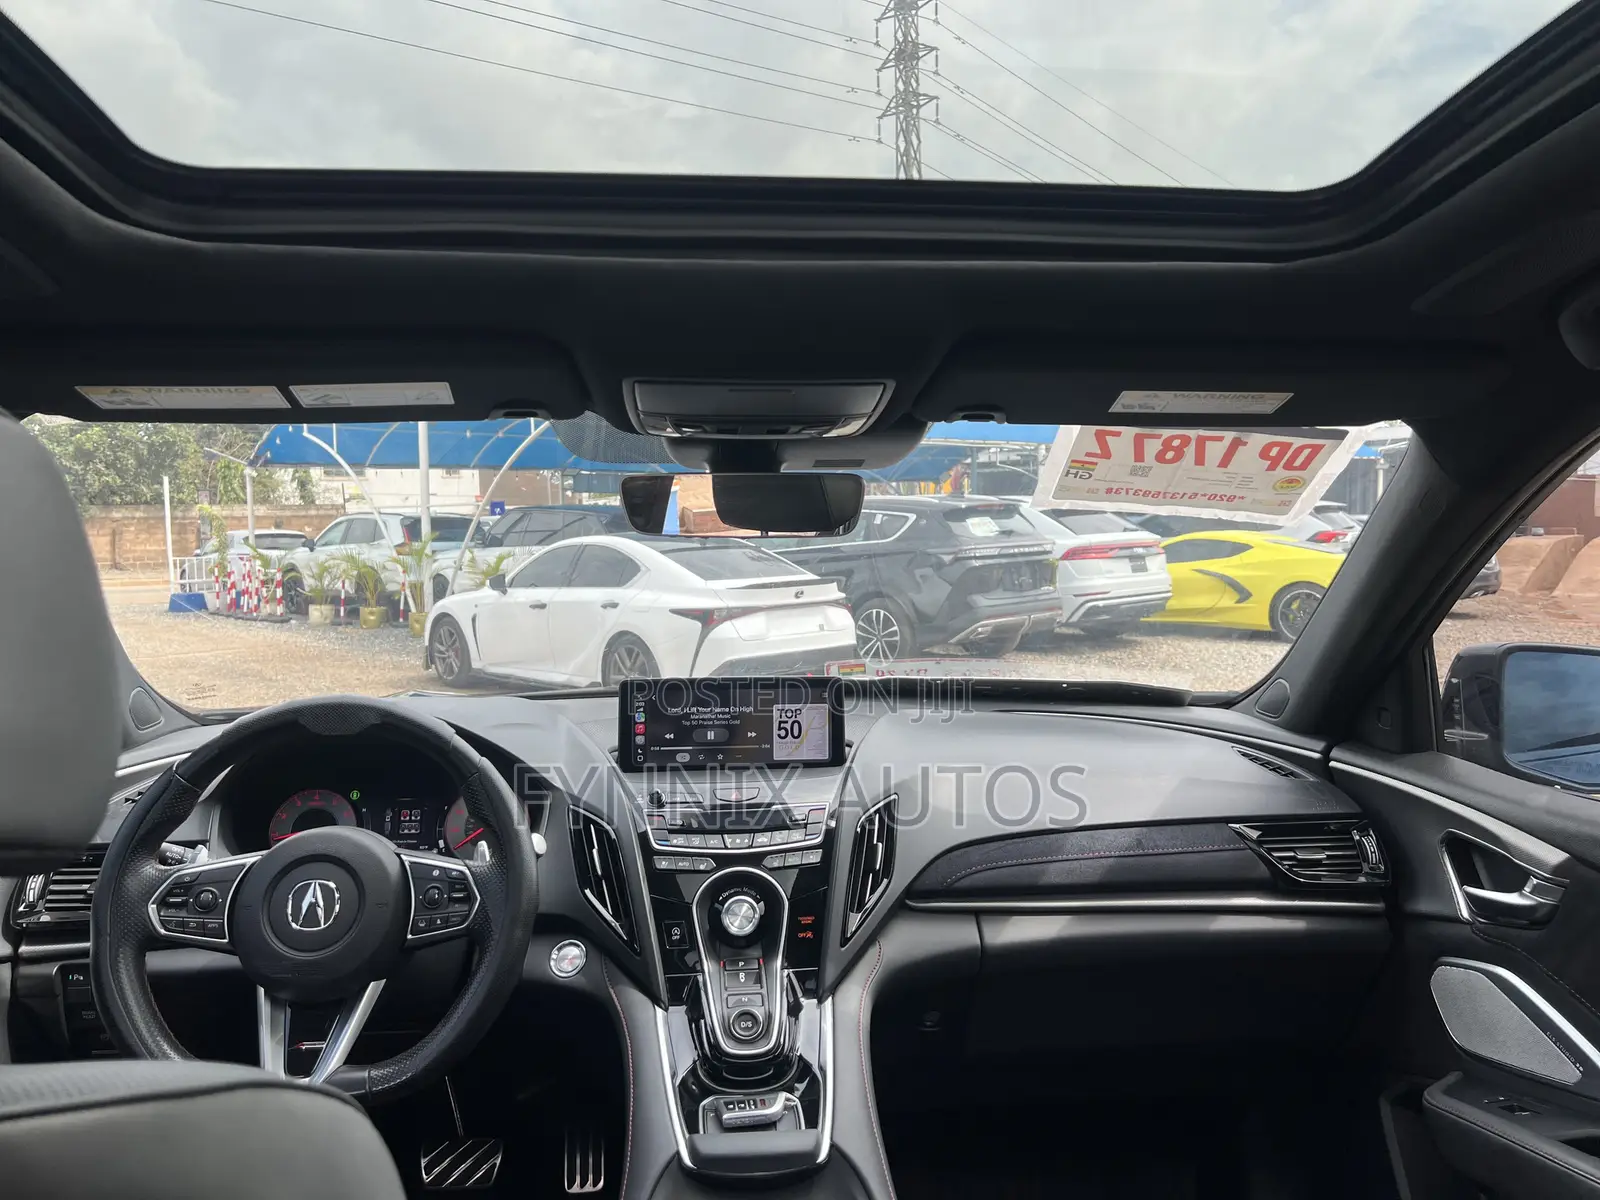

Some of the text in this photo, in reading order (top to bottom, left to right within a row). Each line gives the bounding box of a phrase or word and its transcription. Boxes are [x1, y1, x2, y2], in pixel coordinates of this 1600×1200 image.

[142, 387, 250, 395] WARNING
[1173, 392, 1266, 400] WARNING
[739, 705, 754, 713] High
[776, 708, 803, 719] TOP
[776, 719, 803, 740] 50
